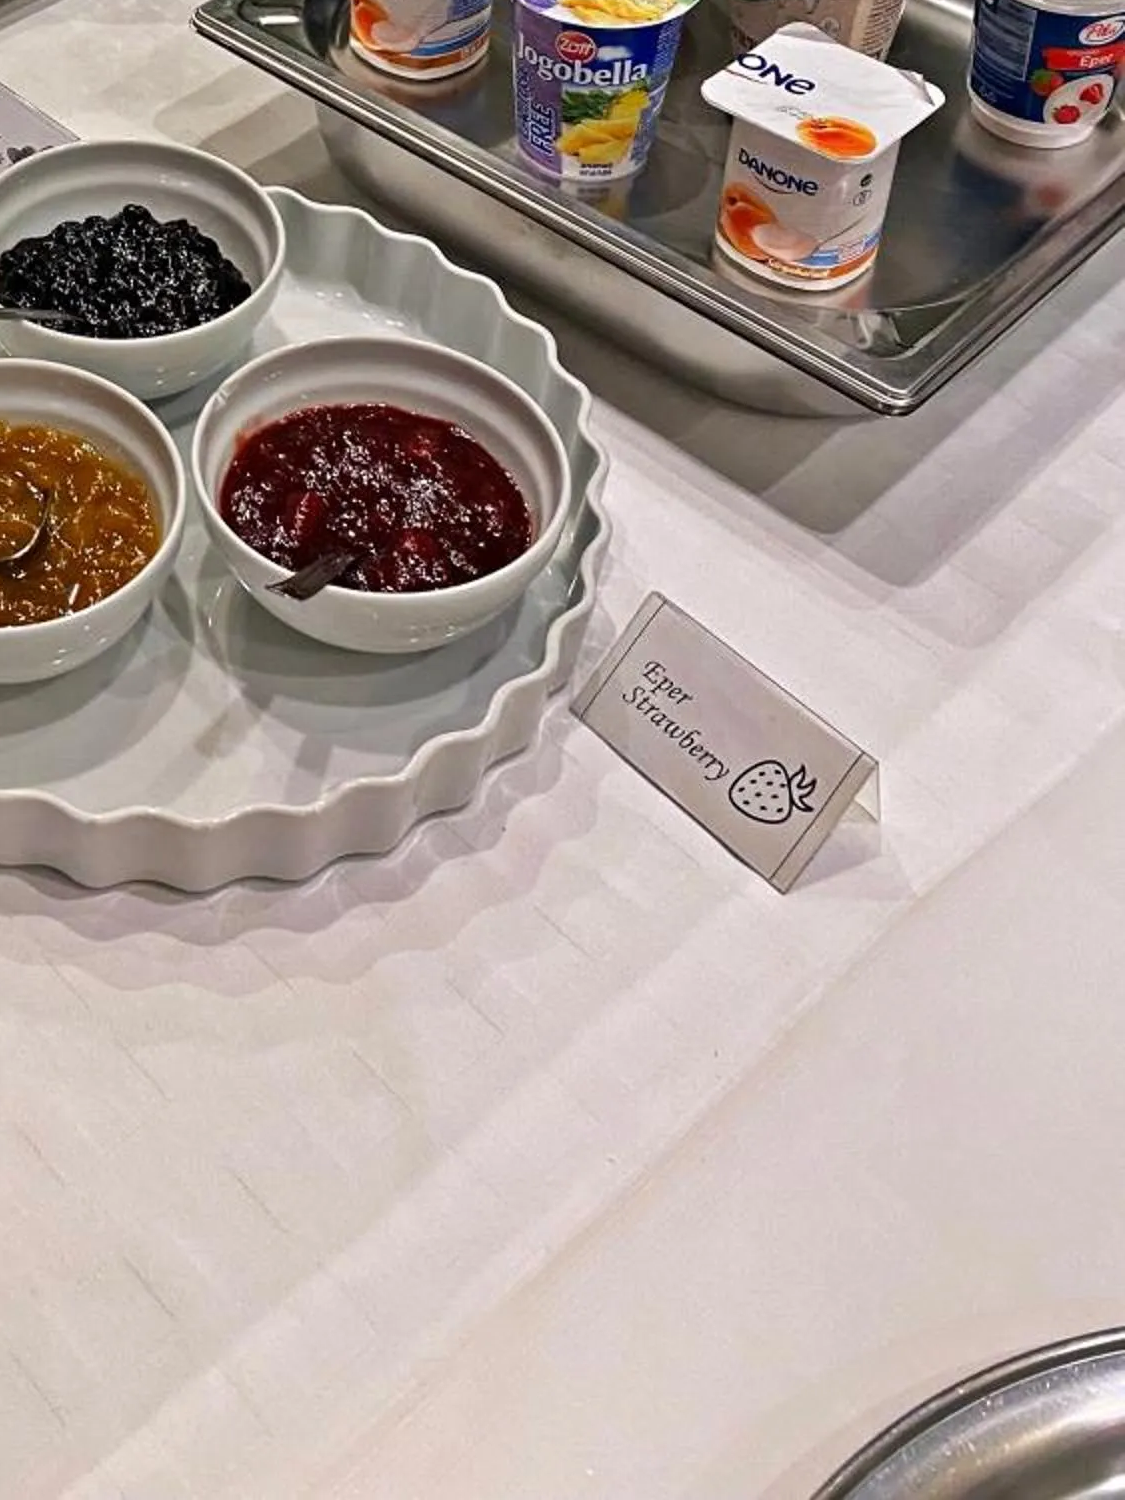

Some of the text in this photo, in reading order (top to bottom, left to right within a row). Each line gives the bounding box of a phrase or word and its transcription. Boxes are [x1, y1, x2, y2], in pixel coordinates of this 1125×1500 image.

[517, 31, 648, 86] Jogobella
[1080, 53, 1115, 69] Eper
[642, 660, 694, 705] Eper
[622, 686, 730, 781] Strawberry
